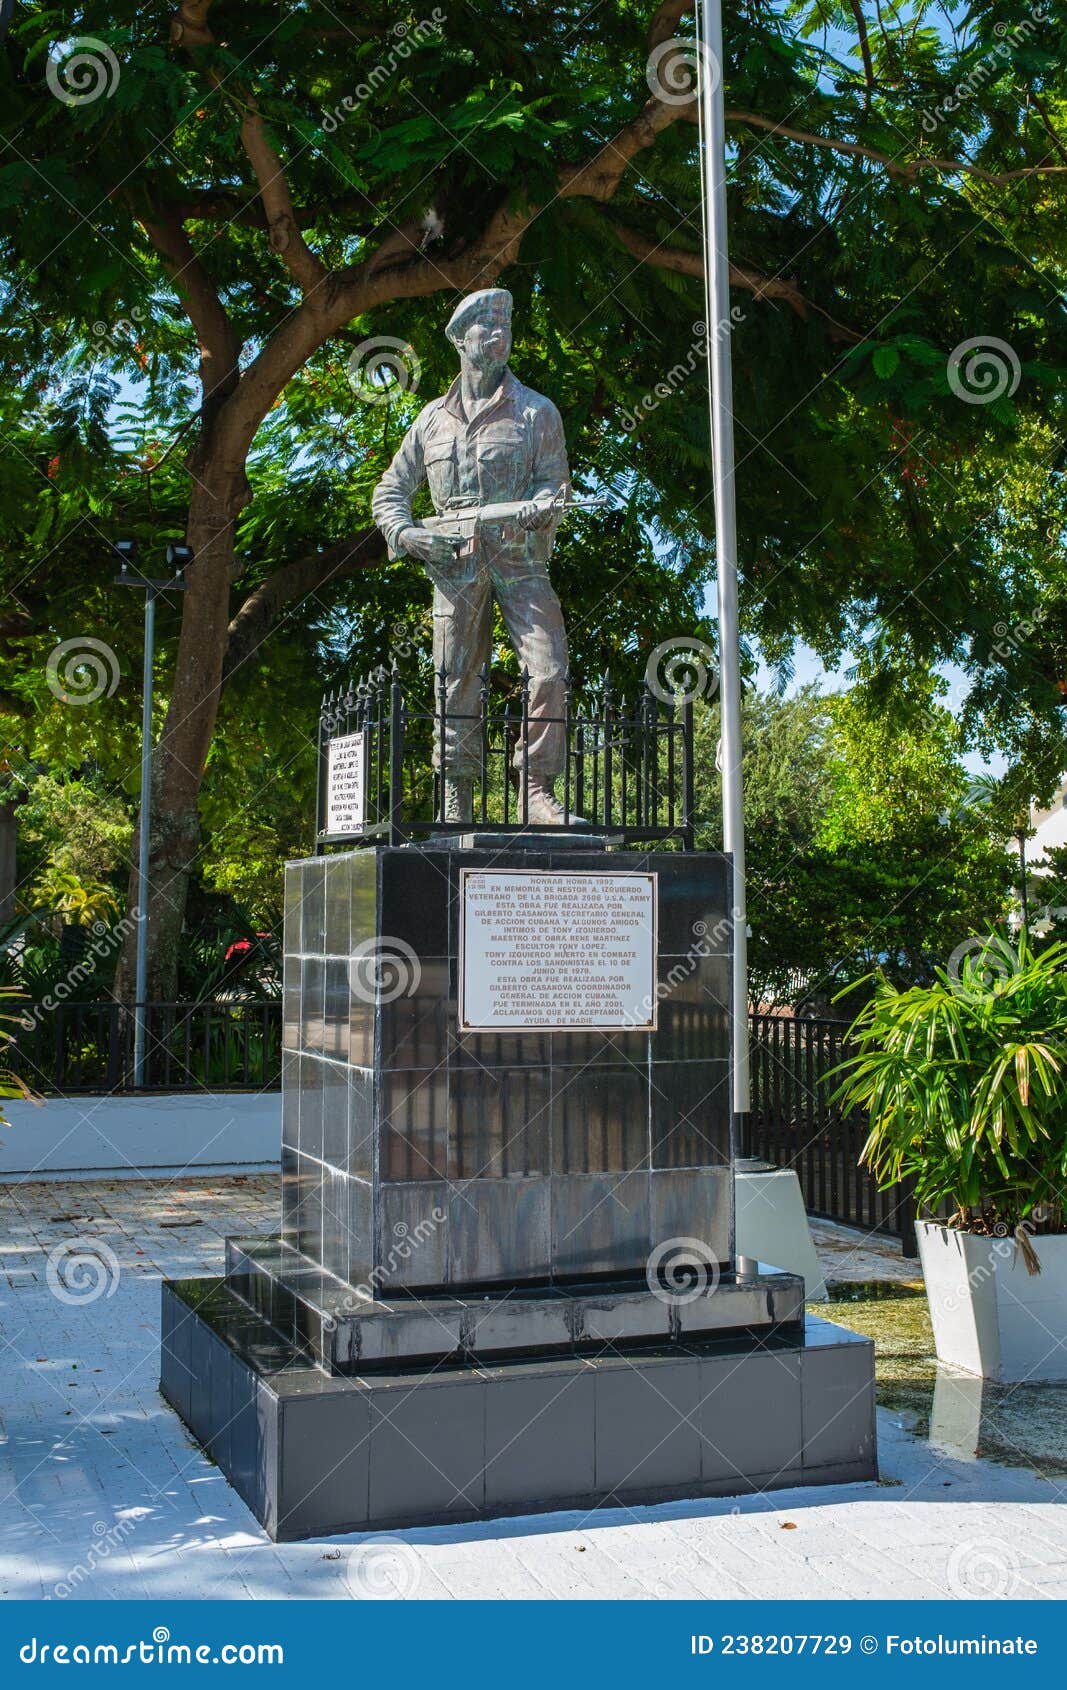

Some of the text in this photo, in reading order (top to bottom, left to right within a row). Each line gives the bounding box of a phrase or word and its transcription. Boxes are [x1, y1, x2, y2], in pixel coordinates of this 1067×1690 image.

[530, 878, 562, 886] HONRAR
[567, 878, 593, 886] HONRA
[469, 893, 511, 901] VETERANO
[518, 893, 527, 901] DE
[531, 893, 541, 901] LA
[544, 893, 578, 901] BRIGADA
[629, 893, 651, 901] ARMY
[474, 910, 646, 918] GILBERTO CASANOVA SECRETARIO GENERAL
[481, 918, 639, 926] DE ACCION CUBANA Y ALGUNOS AMIGOS
